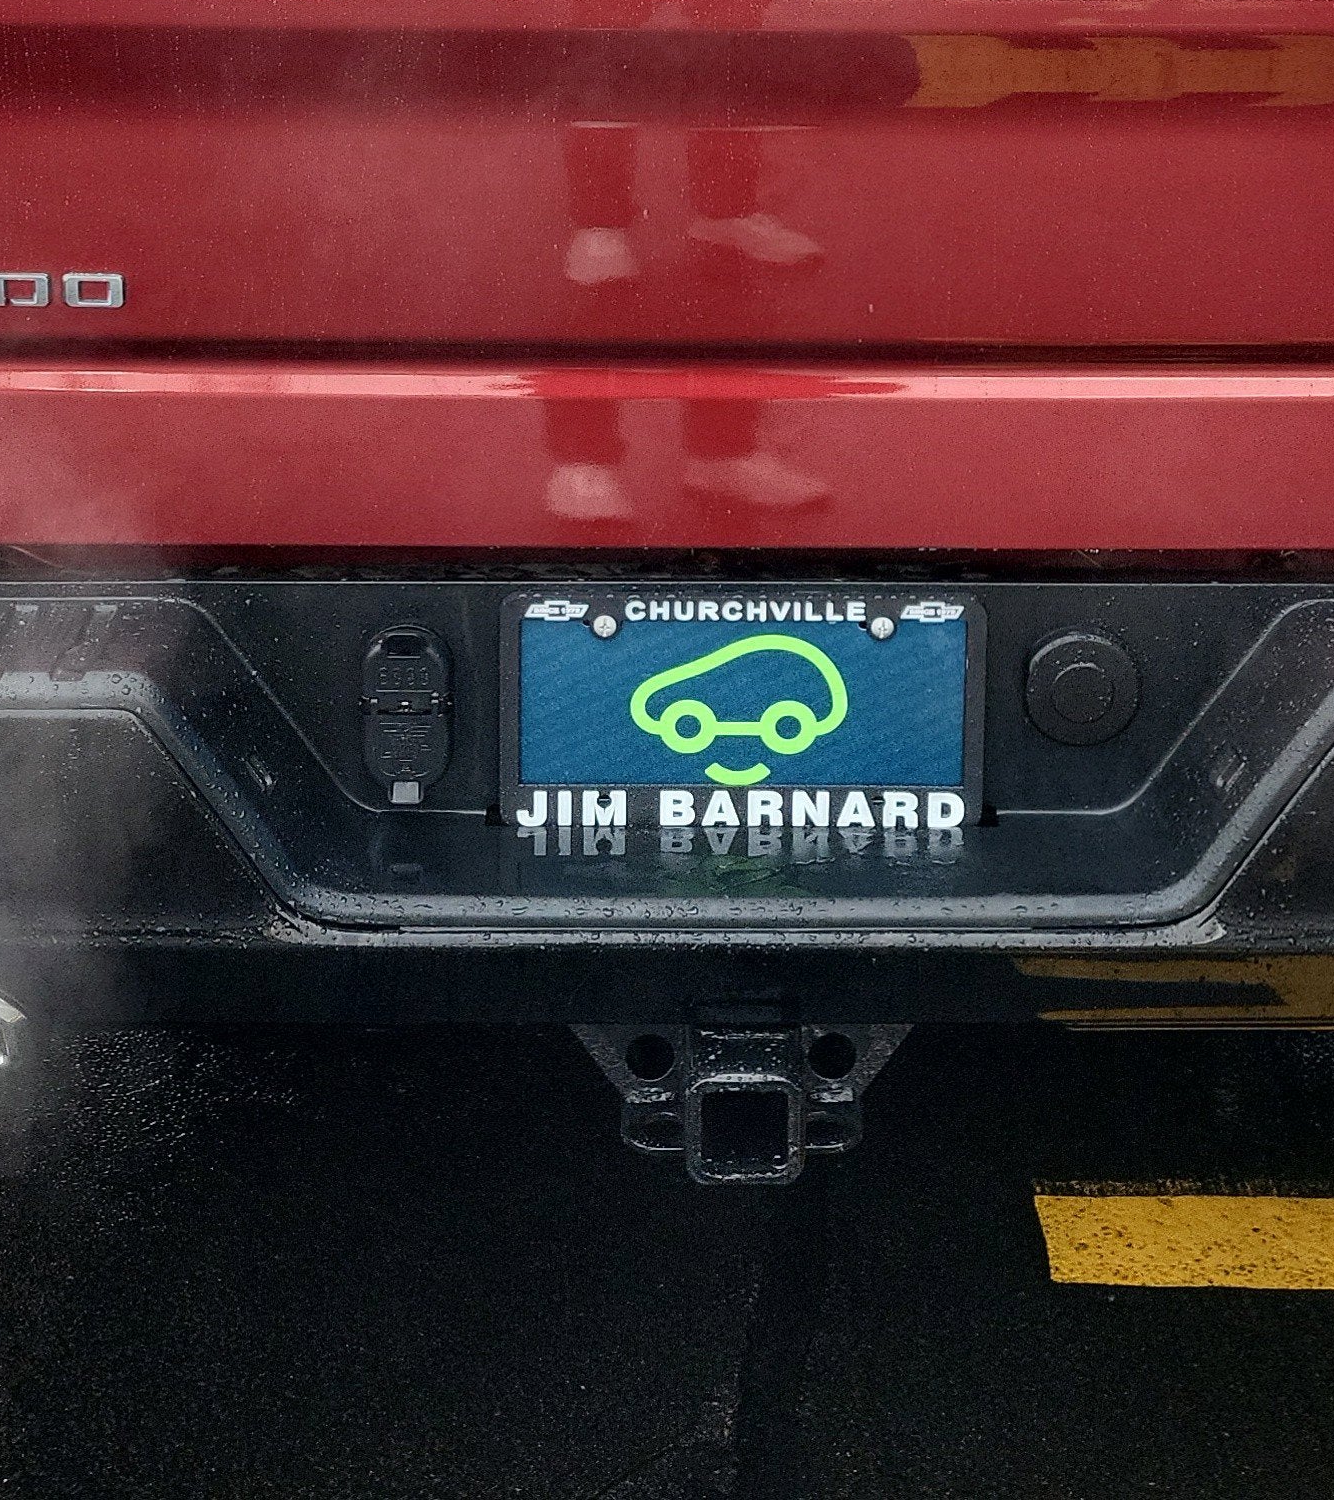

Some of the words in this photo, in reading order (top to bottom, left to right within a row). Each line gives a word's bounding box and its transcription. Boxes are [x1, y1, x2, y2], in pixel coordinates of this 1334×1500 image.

[624, 599, 868, 623] CHURCHVILLE
[515, 789, 628, 828] JIM
[658, 789, 966, 829] BARNARD
